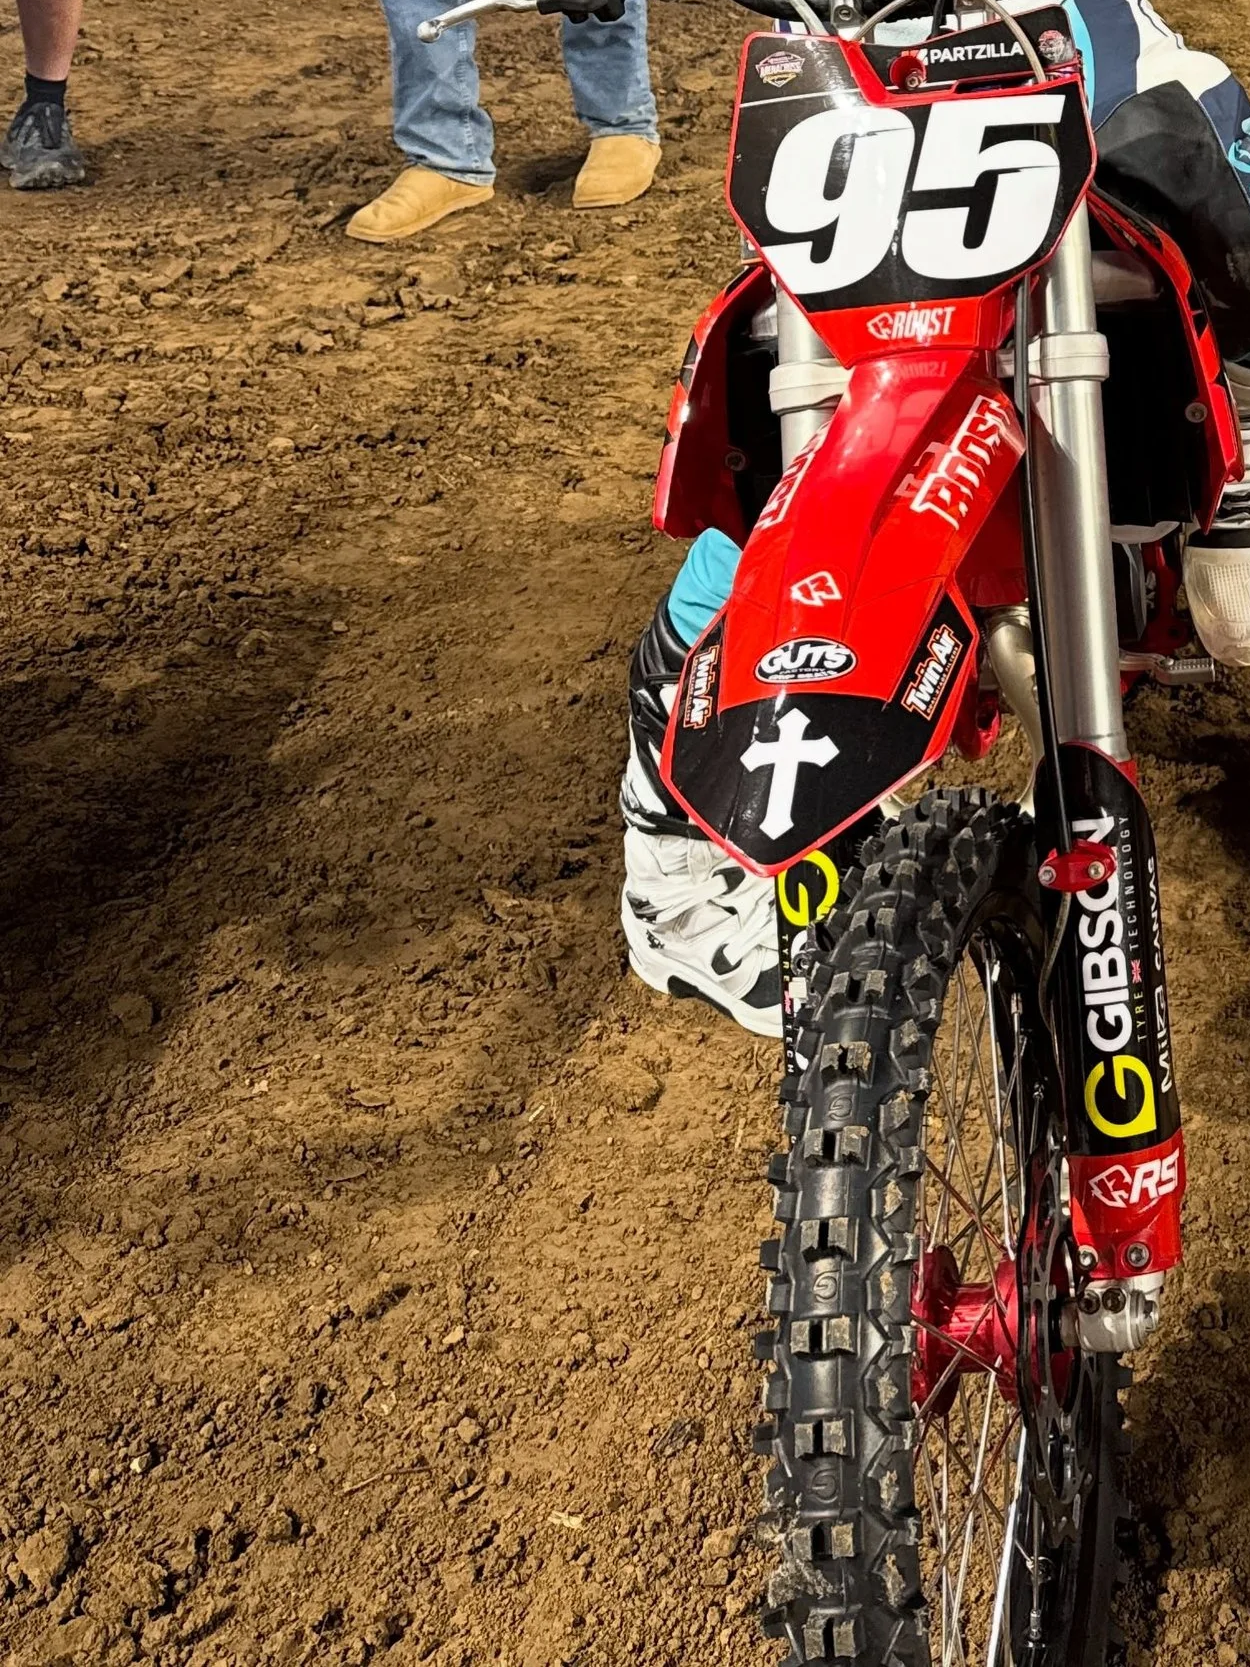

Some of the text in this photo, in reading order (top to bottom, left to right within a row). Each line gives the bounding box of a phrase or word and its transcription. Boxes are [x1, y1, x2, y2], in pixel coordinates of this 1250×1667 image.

[928, 40, 1024, 65] PARTZILLA
[761, 94, 1067, 295] 95
[890, 305, 956, 339] ROOST
[760, 642, 852, 674] GUTS
[1118, 816, 1149, 1043] TYRE TECHNOLOGY
[1147, 855, 1163, 971] CANVAS
[781, 933, 795, 1075] TYRE TECH
